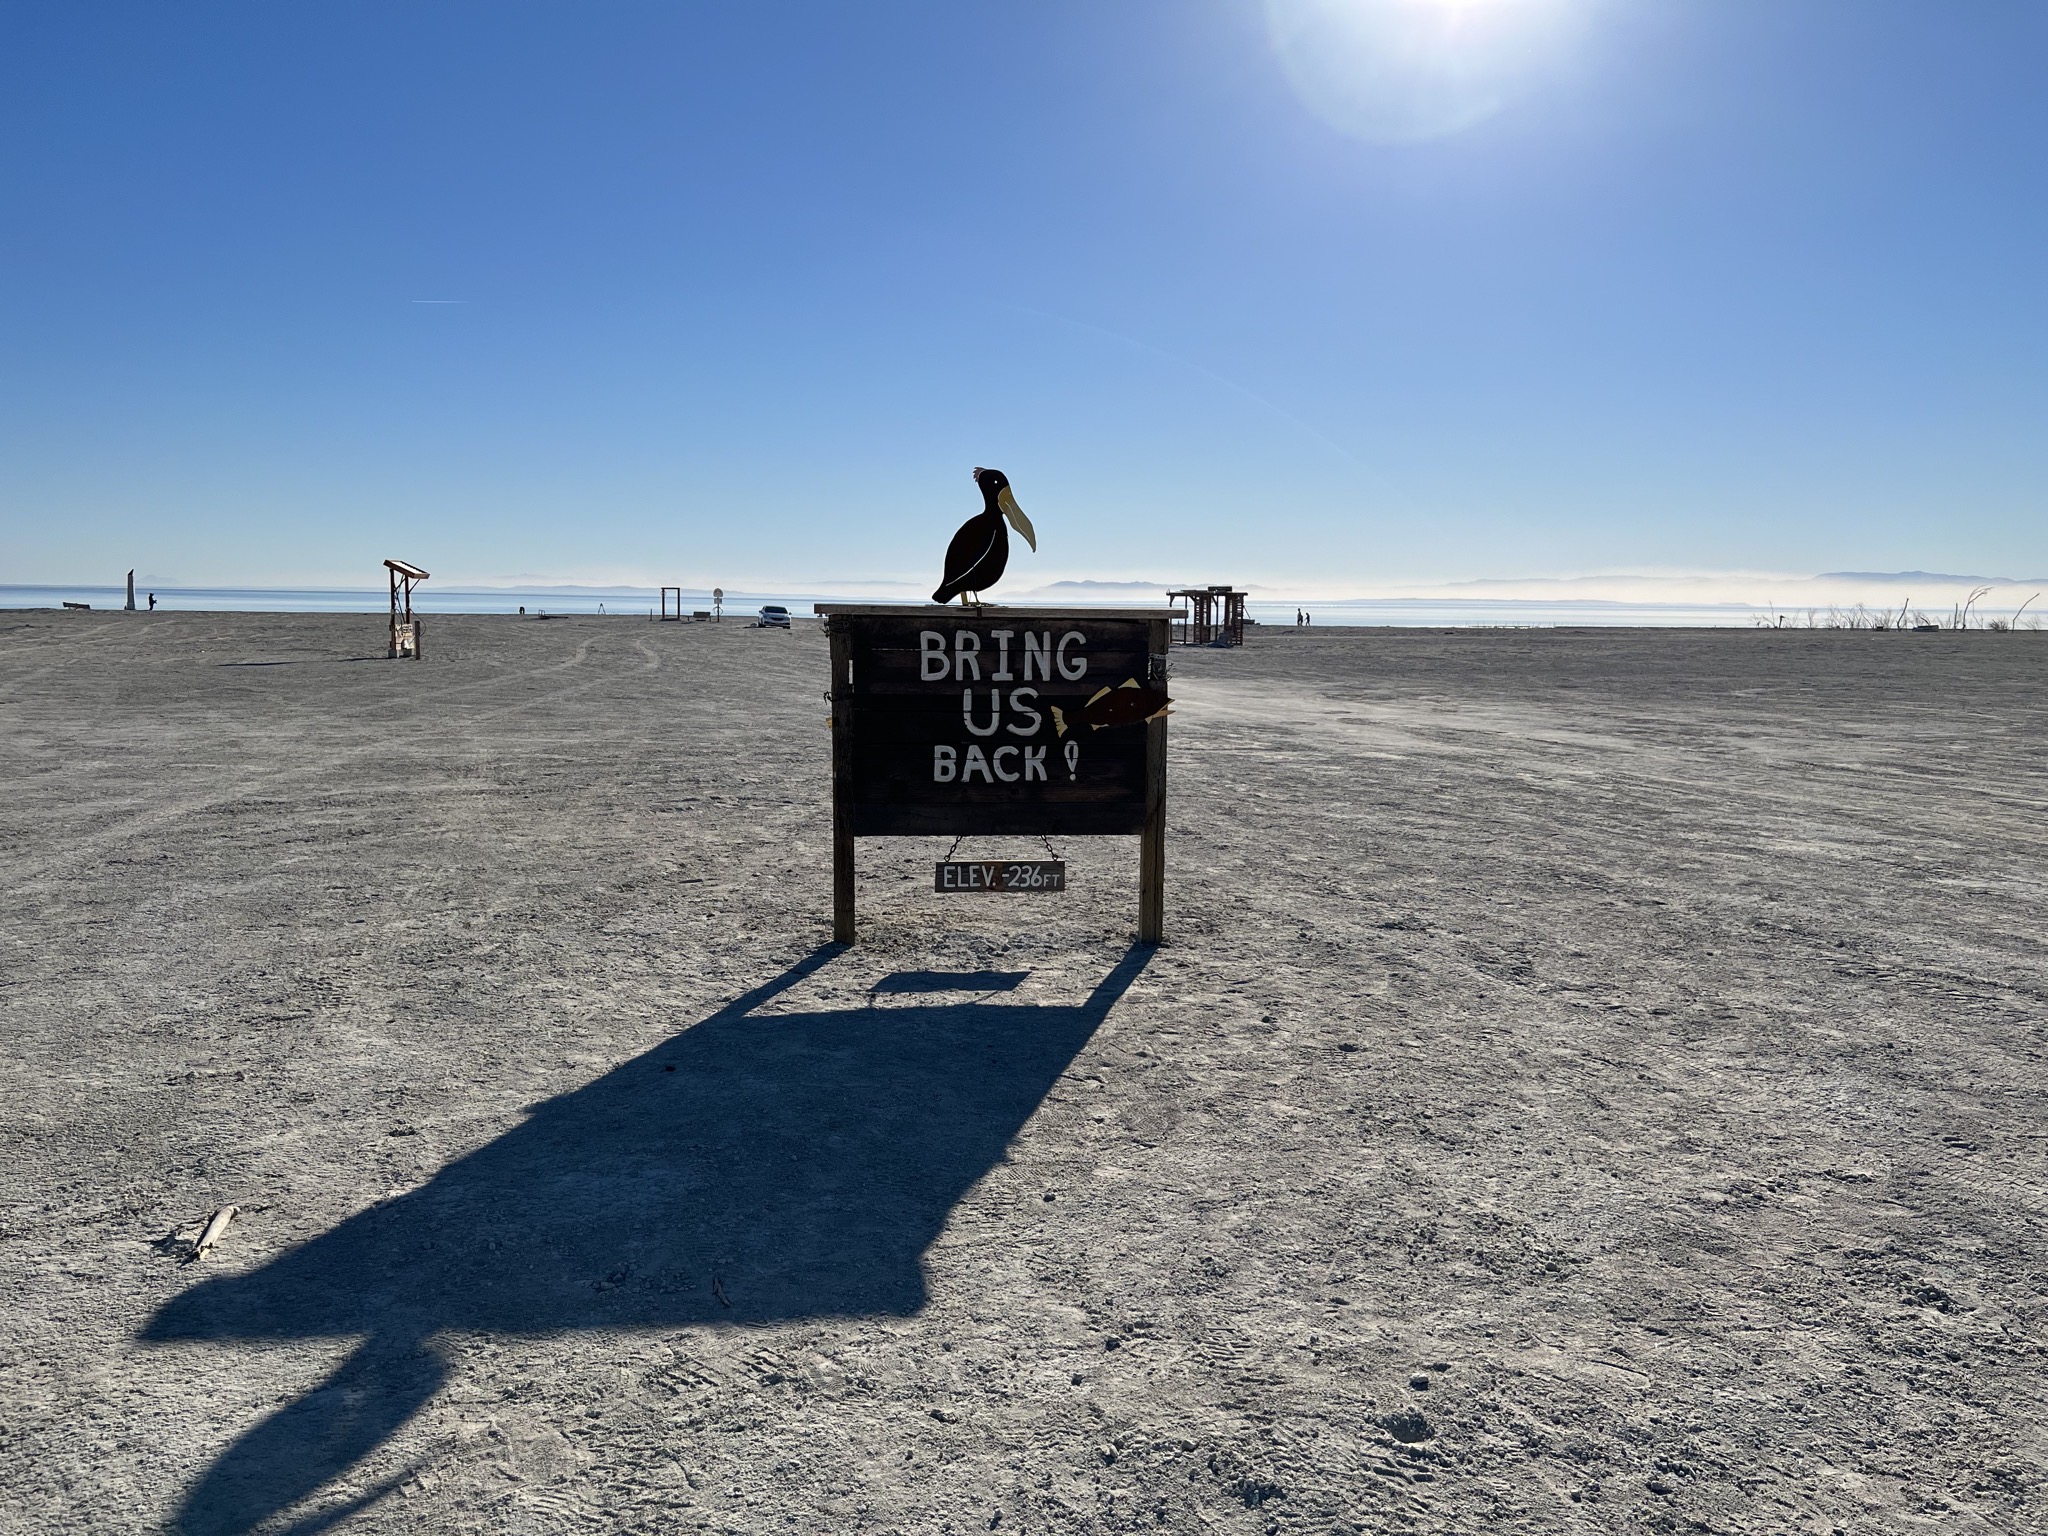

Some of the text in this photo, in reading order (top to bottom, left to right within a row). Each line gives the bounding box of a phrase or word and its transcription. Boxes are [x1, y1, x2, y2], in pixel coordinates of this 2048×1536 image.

[920, 630, 1087, 681] BRING
[963, 687, 1041, 736] US
[943, 865, 996, 887] ELEV.
